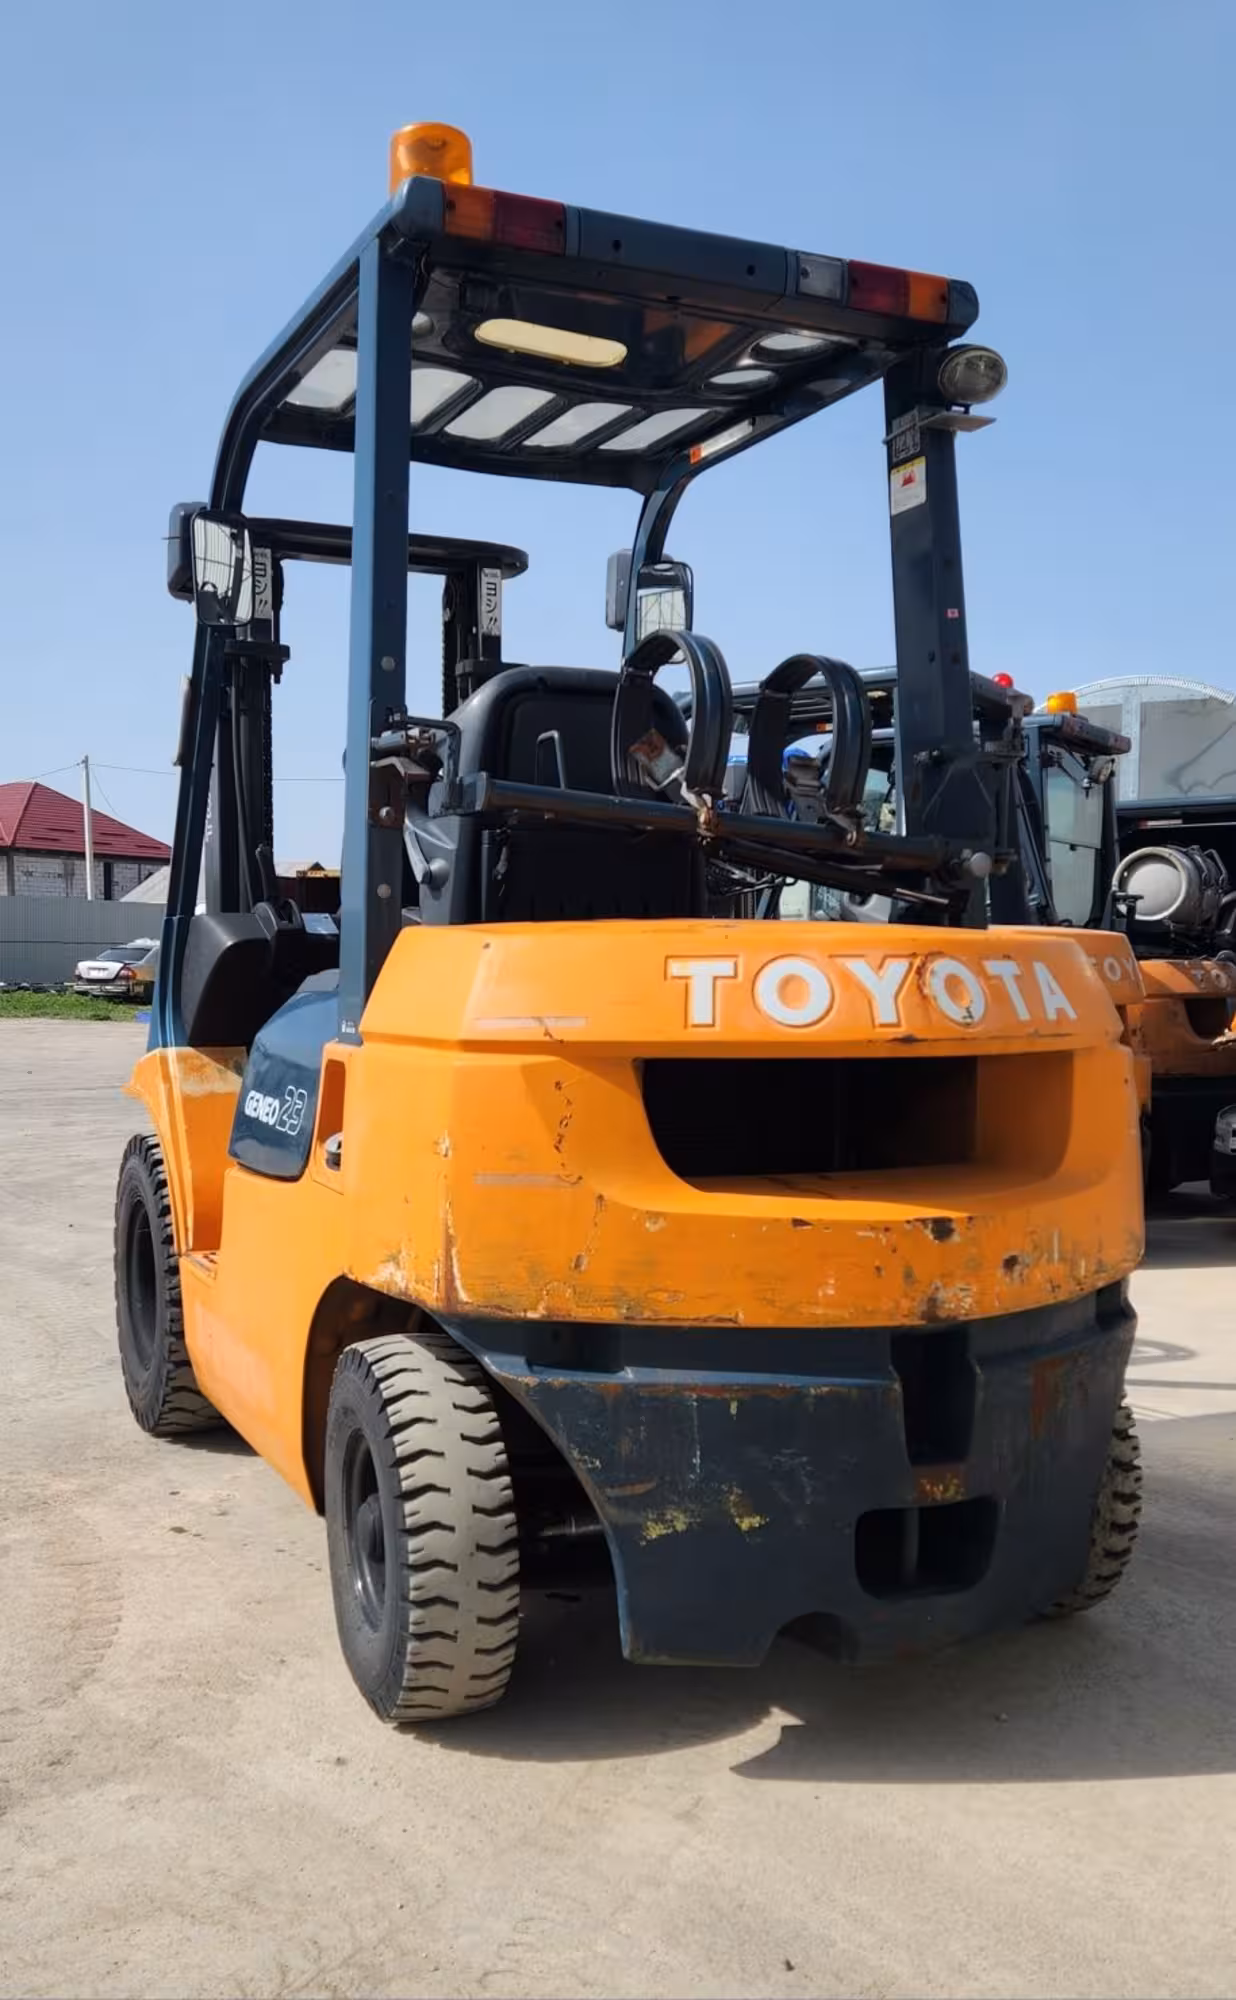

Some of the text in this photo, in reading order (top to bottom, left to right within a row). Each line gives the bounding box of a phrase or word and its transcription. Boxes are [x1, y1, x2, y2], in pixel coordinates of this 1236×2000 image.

[667, 955, 1077, 1026] TOYOTA
[245, 1086, 308, 1136] GENEO 23
